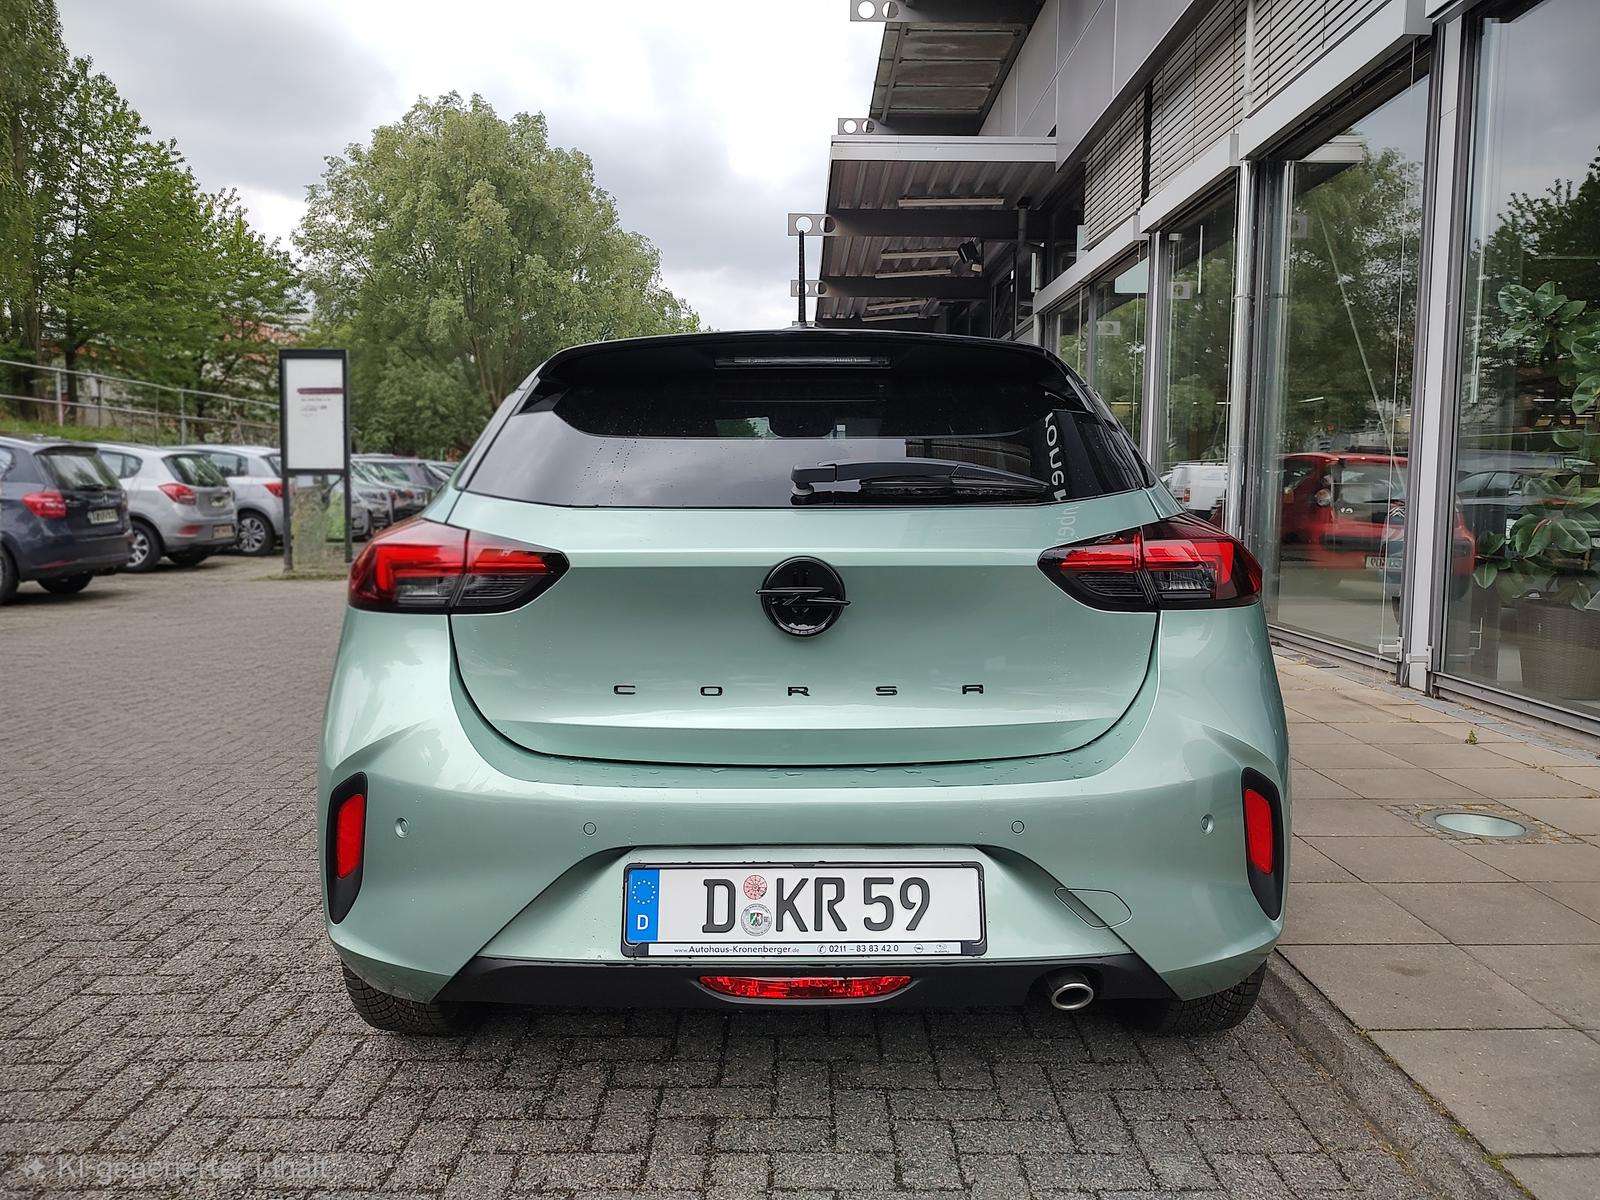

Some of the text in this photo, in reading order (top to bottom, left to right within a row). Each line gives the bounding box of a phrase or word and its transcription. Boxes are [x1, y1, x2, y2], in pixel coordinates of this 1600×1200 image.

[613, 684, 984, 697] CORSA
[702, 877, 931, 933] D KR 59
[637, 914, 649, 930] D
